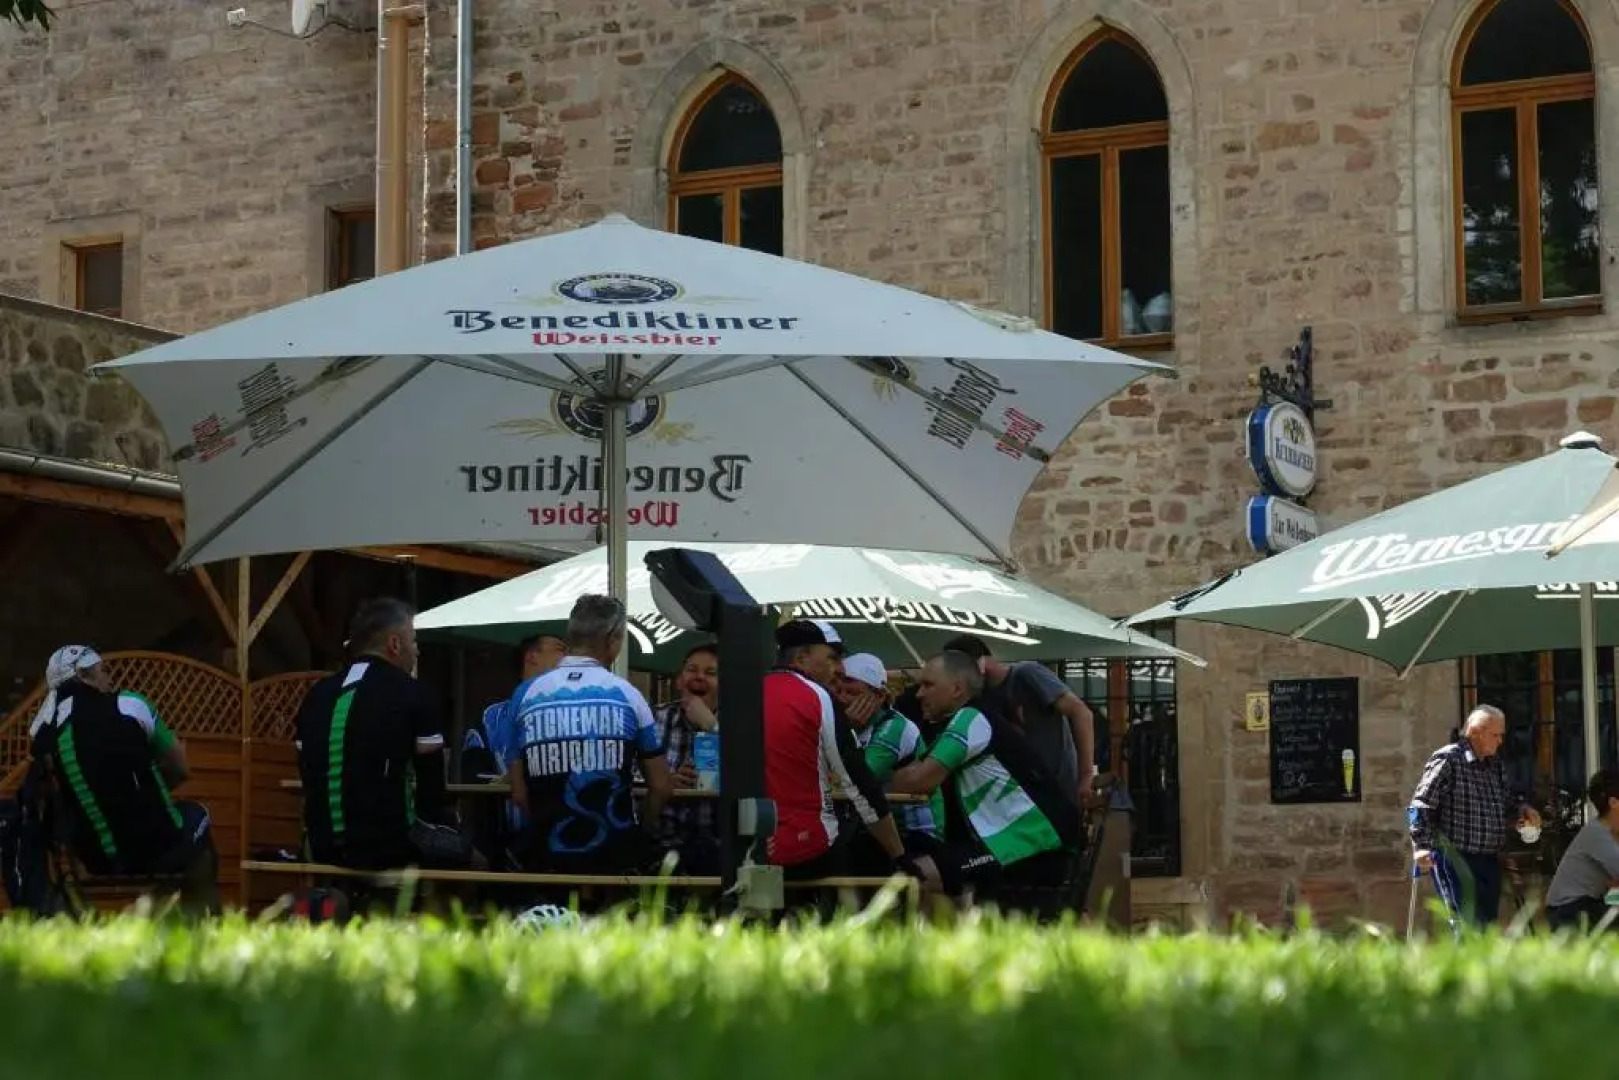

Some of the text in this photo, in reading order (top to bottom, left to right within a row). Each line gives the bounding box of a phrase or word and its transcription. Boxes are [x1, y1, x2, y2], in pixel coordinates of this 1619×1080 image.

[444, 309, 799, 334] Benediktiner
[531, 331, 722, 346] Weissbier
[524, 704, 624, 742] STONEMAN
